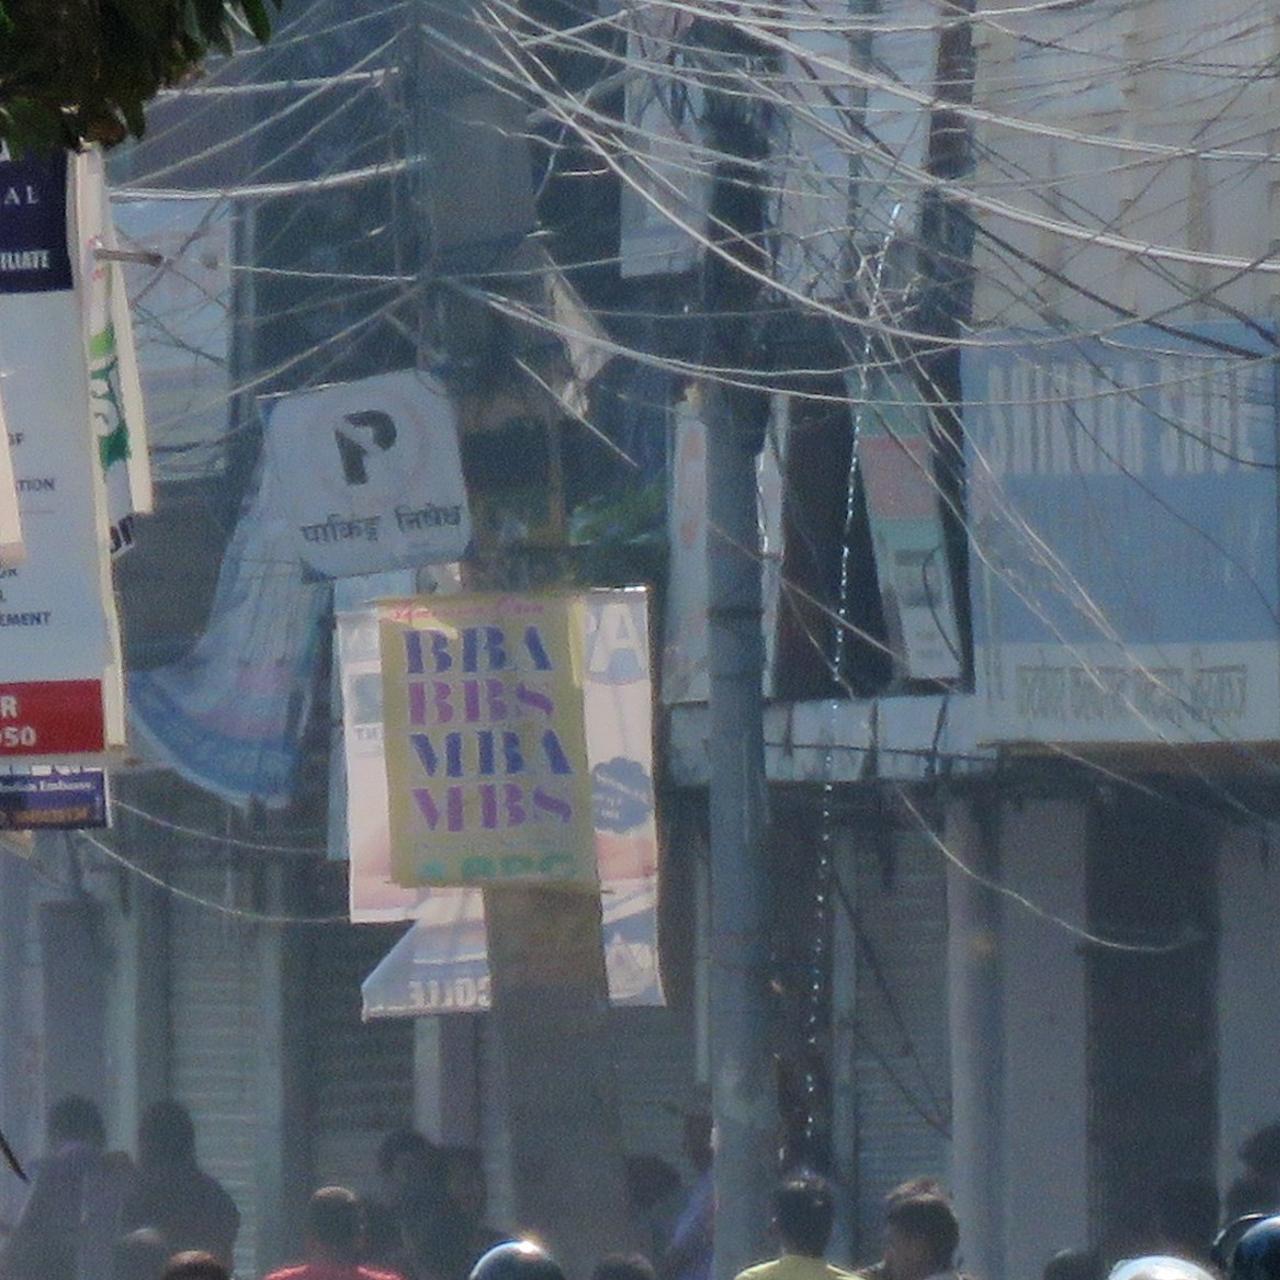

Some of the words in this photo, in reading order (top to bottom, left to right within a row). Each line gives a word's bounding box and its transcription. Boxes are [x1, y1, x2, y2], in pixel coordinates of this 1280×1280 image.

[335, 410, 398, 487] P
[405, 626, 553, 674] BBA
[408, 679, 554, 726] BBS
[0, 726, 37, 747] 50
[410, 729, 575, 778] MBA
[411, 784, 575, 833] MBS
